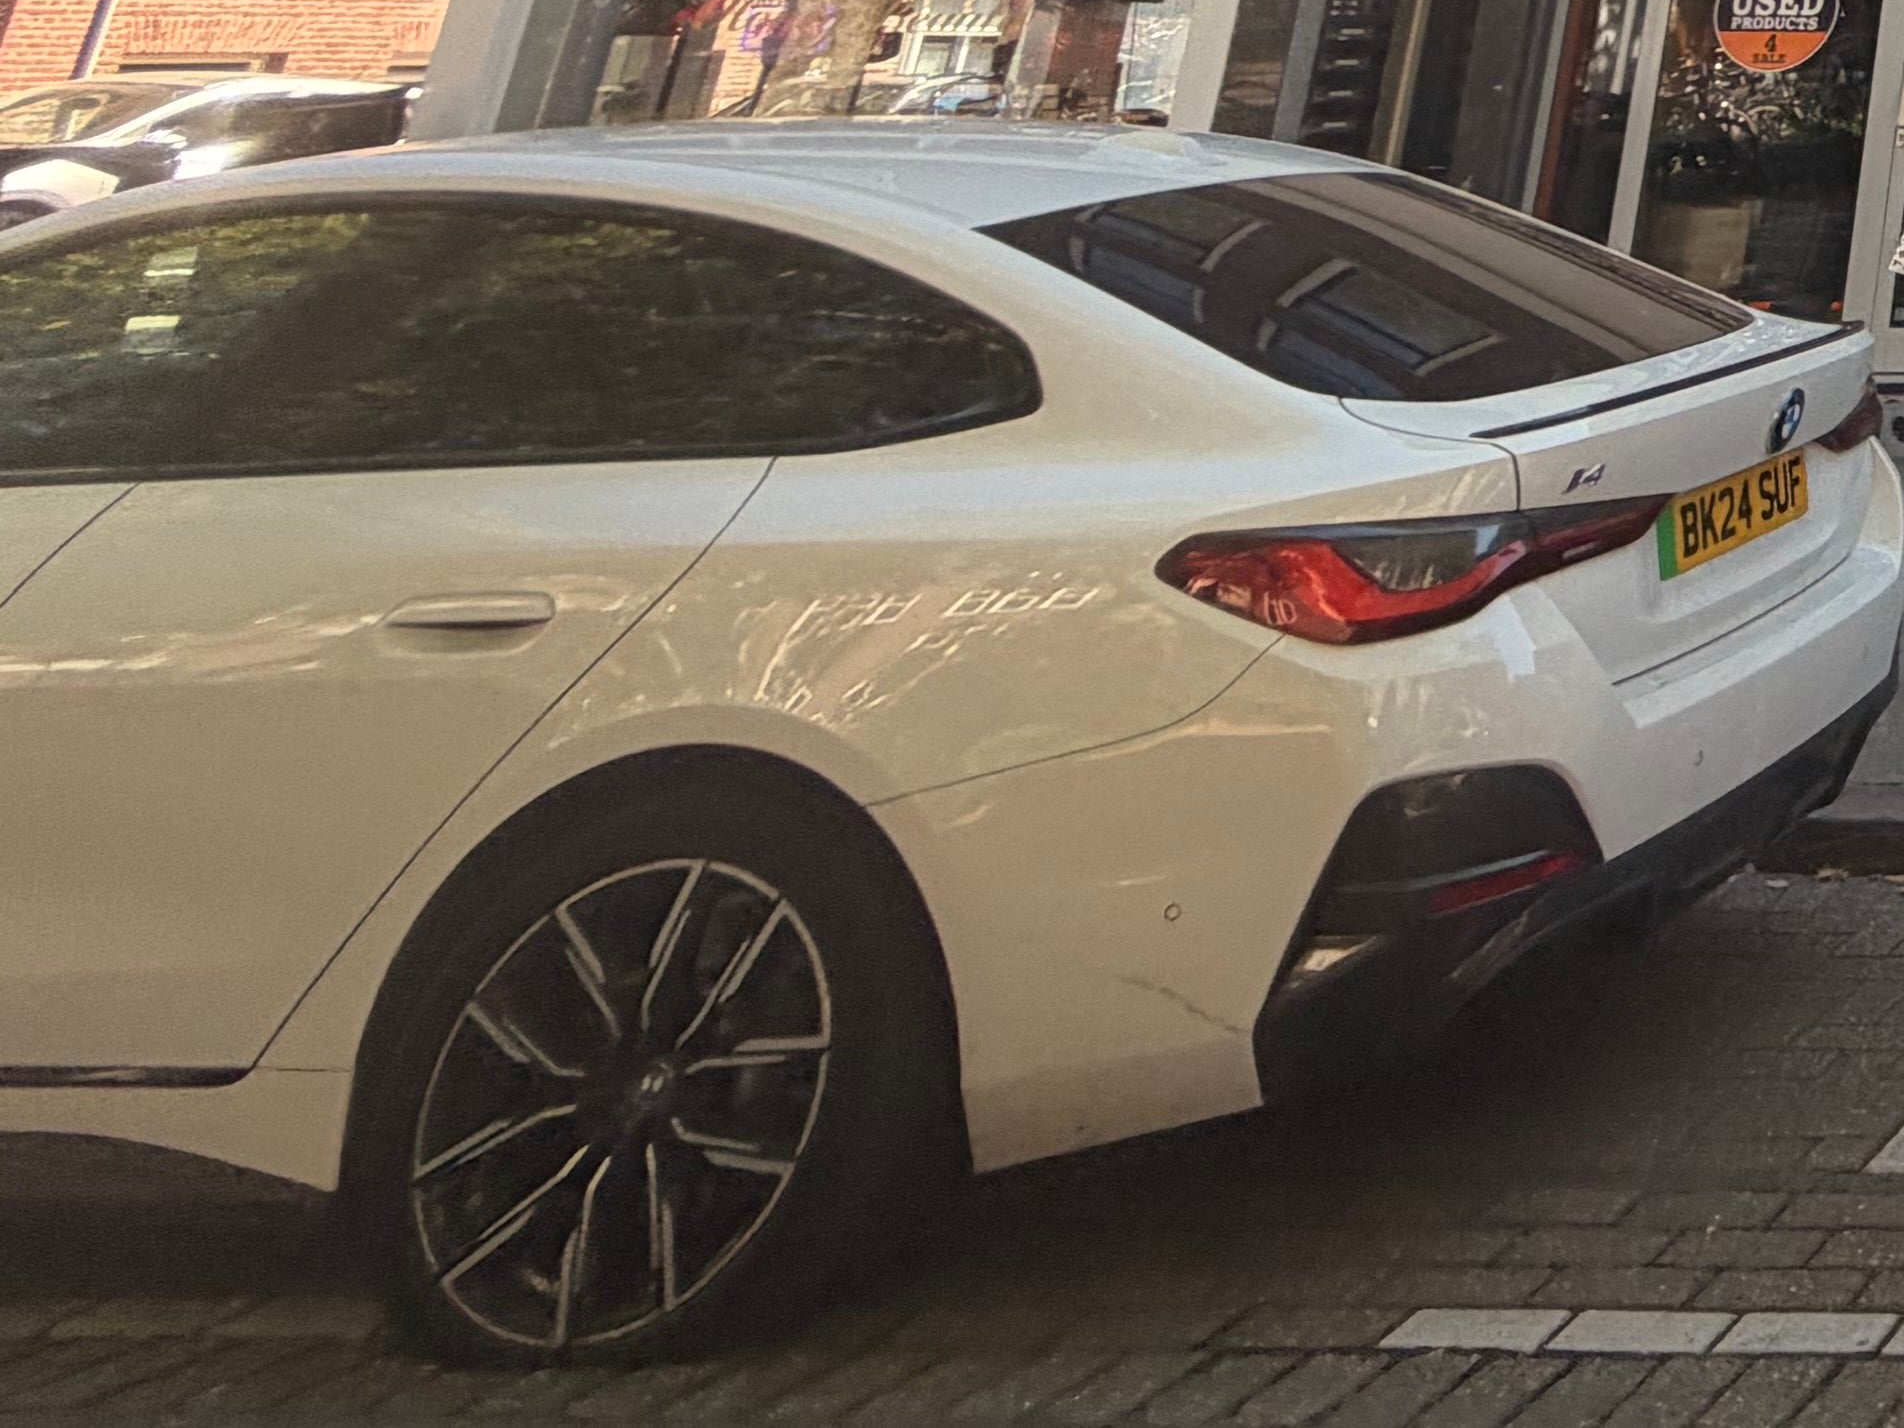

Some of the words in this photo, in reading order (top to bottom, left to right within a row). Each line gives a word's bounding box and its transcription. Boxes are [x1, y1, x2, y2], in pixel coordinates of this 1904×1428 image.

[1730, 17, 1819, 31] PRODUCTS
[1764, 33, 1777, 53] 4
[1679, 478, 1753, 559] BK24
[1757, 455, 1801, 521] SUF
